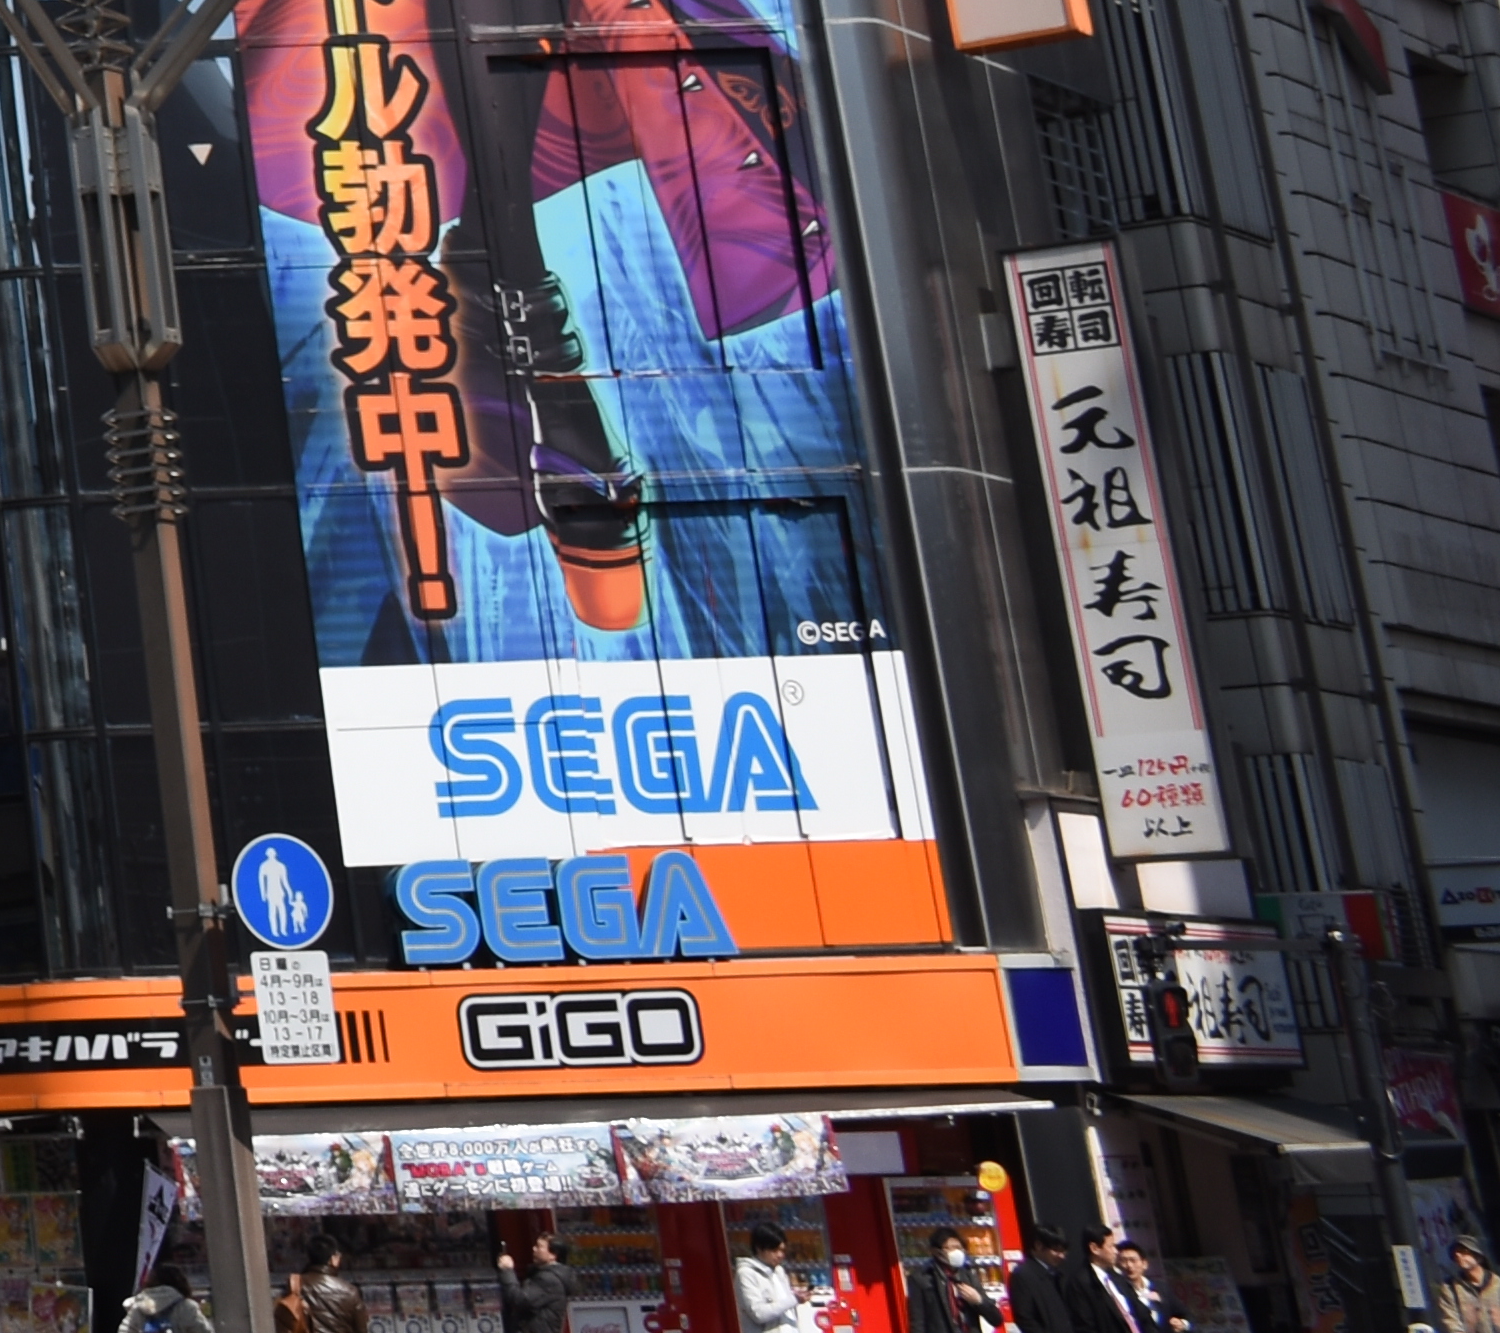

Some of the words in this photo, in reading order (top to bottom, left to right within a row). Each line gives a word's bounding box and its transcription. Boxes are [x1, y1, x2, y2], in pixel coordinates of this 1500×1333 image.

[1049, 385, 1174, 701] 元祖寿司
[427, 689, 820, 818] SEGA
[1142, 816, 1193, 837] 以上
[392, 849, 741, 966] SEGA
